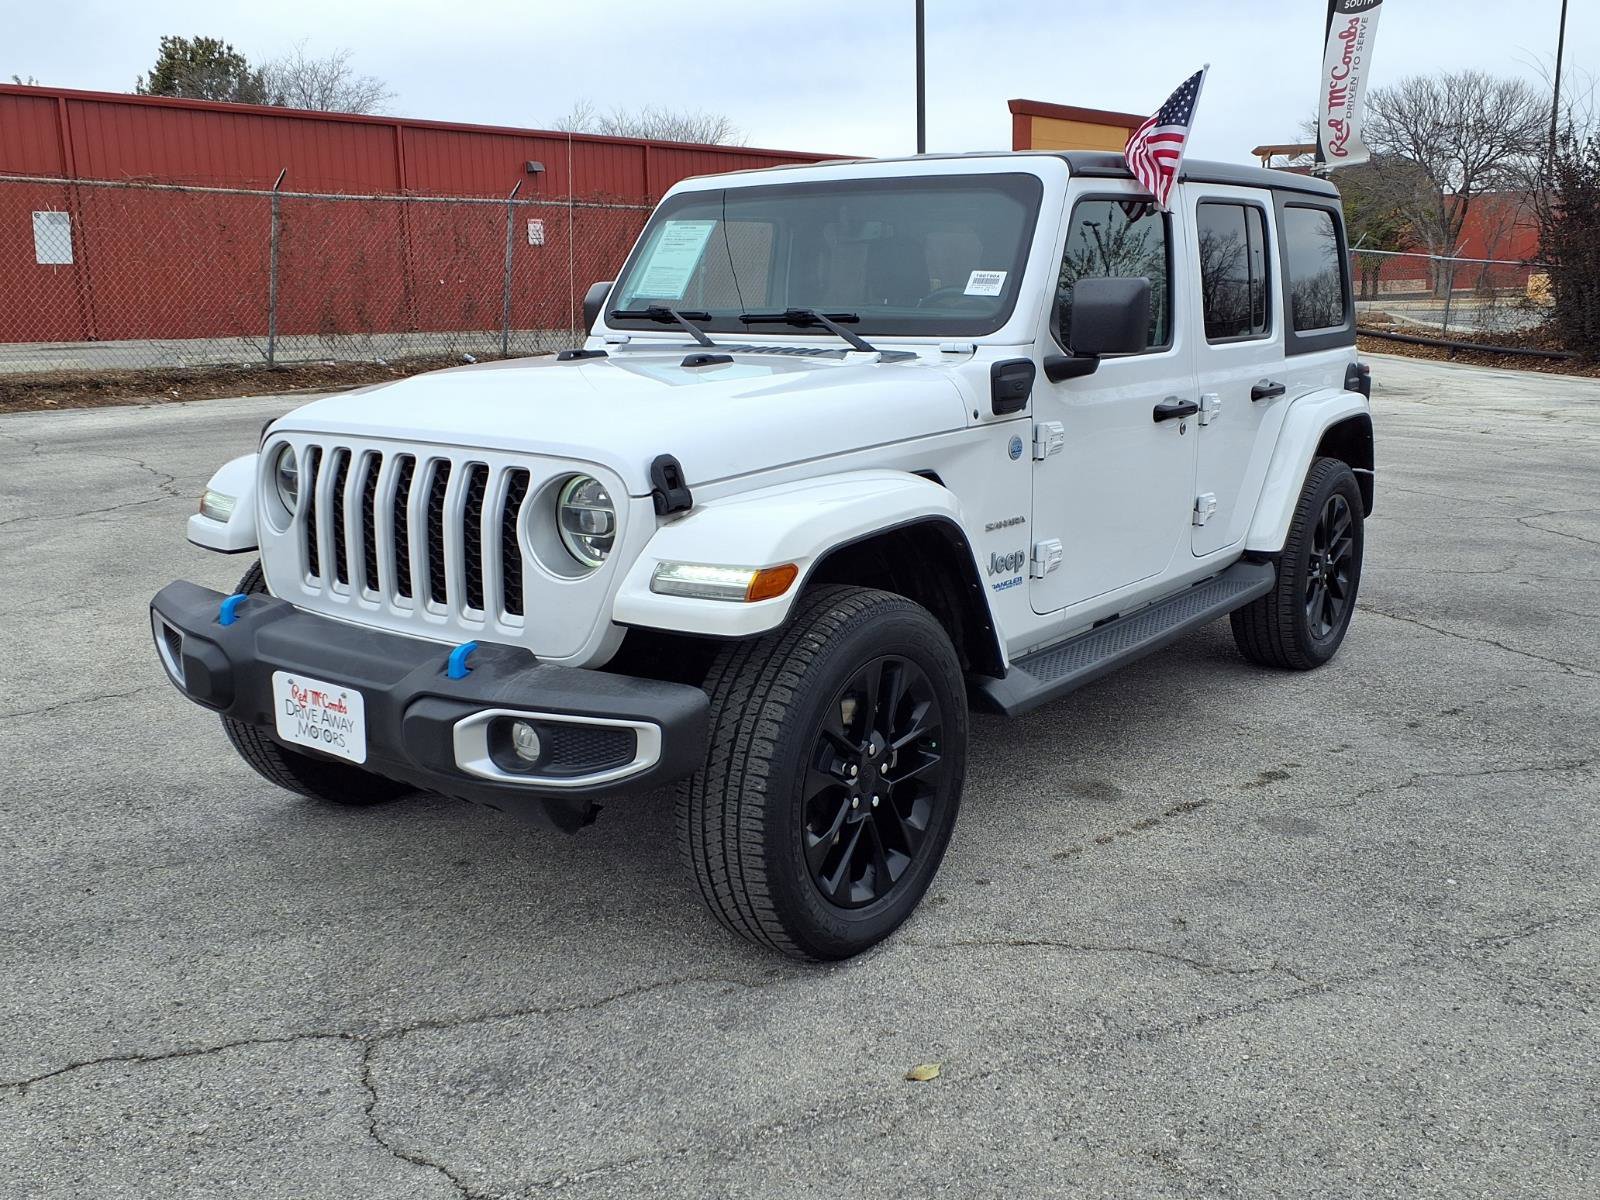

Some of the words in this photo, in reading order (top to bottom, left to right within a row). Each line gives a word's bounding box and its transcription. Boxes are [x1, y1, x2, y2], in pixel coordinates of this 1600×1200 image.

[1356, 17, 1369, 51] SERVE
[1328, 16, 1360, 115] McCombs
[1352, 56, 1361, 70] TO
[1346, 77, 1358, 119] DRIVEN
[1328, 118, 1350, 158] Red
[987, 550, 1025, 576] Jeep
[291, 684, 308, 708] Red
[309, 689, 348, 714] McCombs
[285, 699, 318, 723] DRIVE
[321, 709, 354, 734] AWAY
[298, 720, 346, 747] MOTORS
